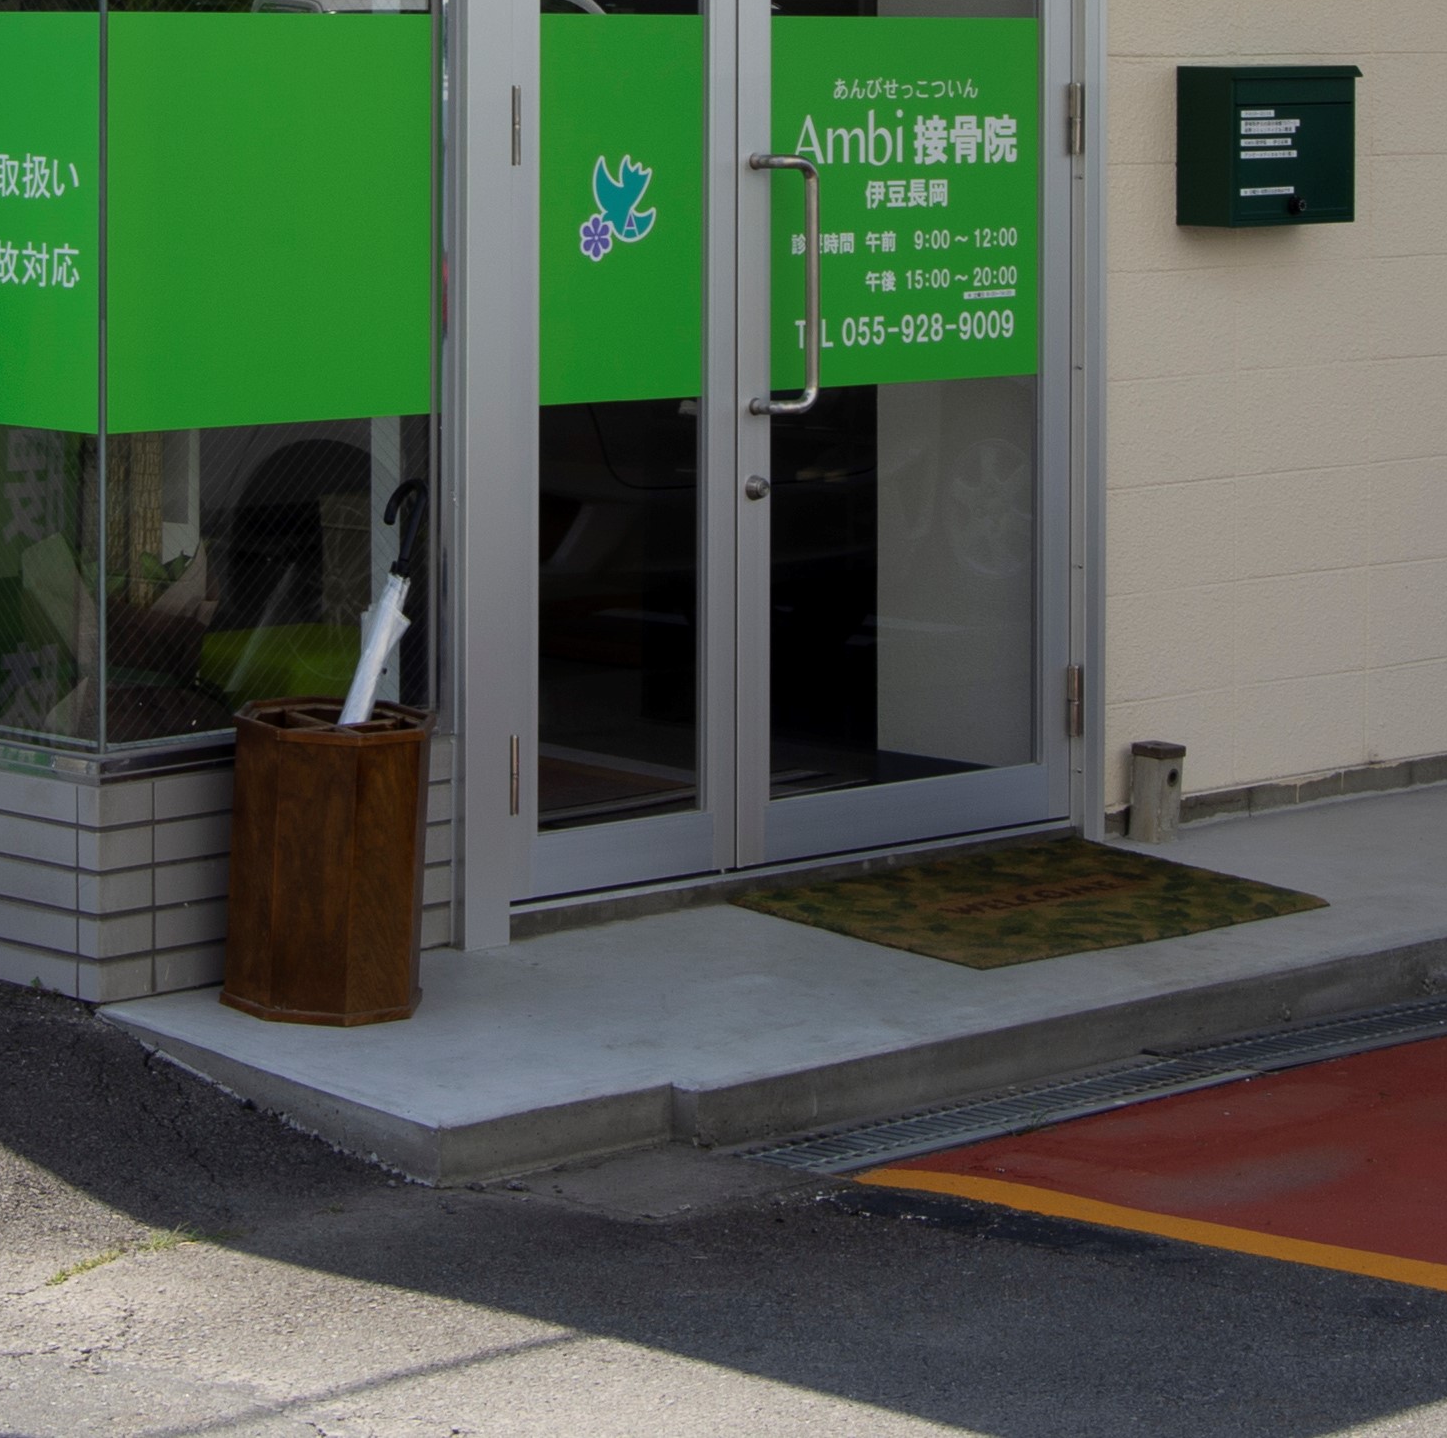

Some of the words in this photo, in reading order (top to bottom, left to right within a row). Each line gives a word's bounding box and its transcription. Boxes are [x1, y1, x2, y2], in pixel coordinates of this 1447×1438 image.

[832, 76, 979, 100] あんびせっこついん
[794, 109, 905, 167] Ambi
[912, 113, 1019, 166] 接骨院
[864, 178, 949, 210] 伊豆長岡
[790, 232, 855, 255] 診時間
[865, 230, 897, 253] 午前
[914, 229, 950, 250] 9:00
[973, 227, 1018, 249] 12:00
[865, 270, 897, 293] 午後
[904, 268, 951, 290] 15:00
[972, 265, 1018, 288] 20:00
[794, 318, 835, 350] TL
[841, 309, 1015, 349] 055-928-9009
